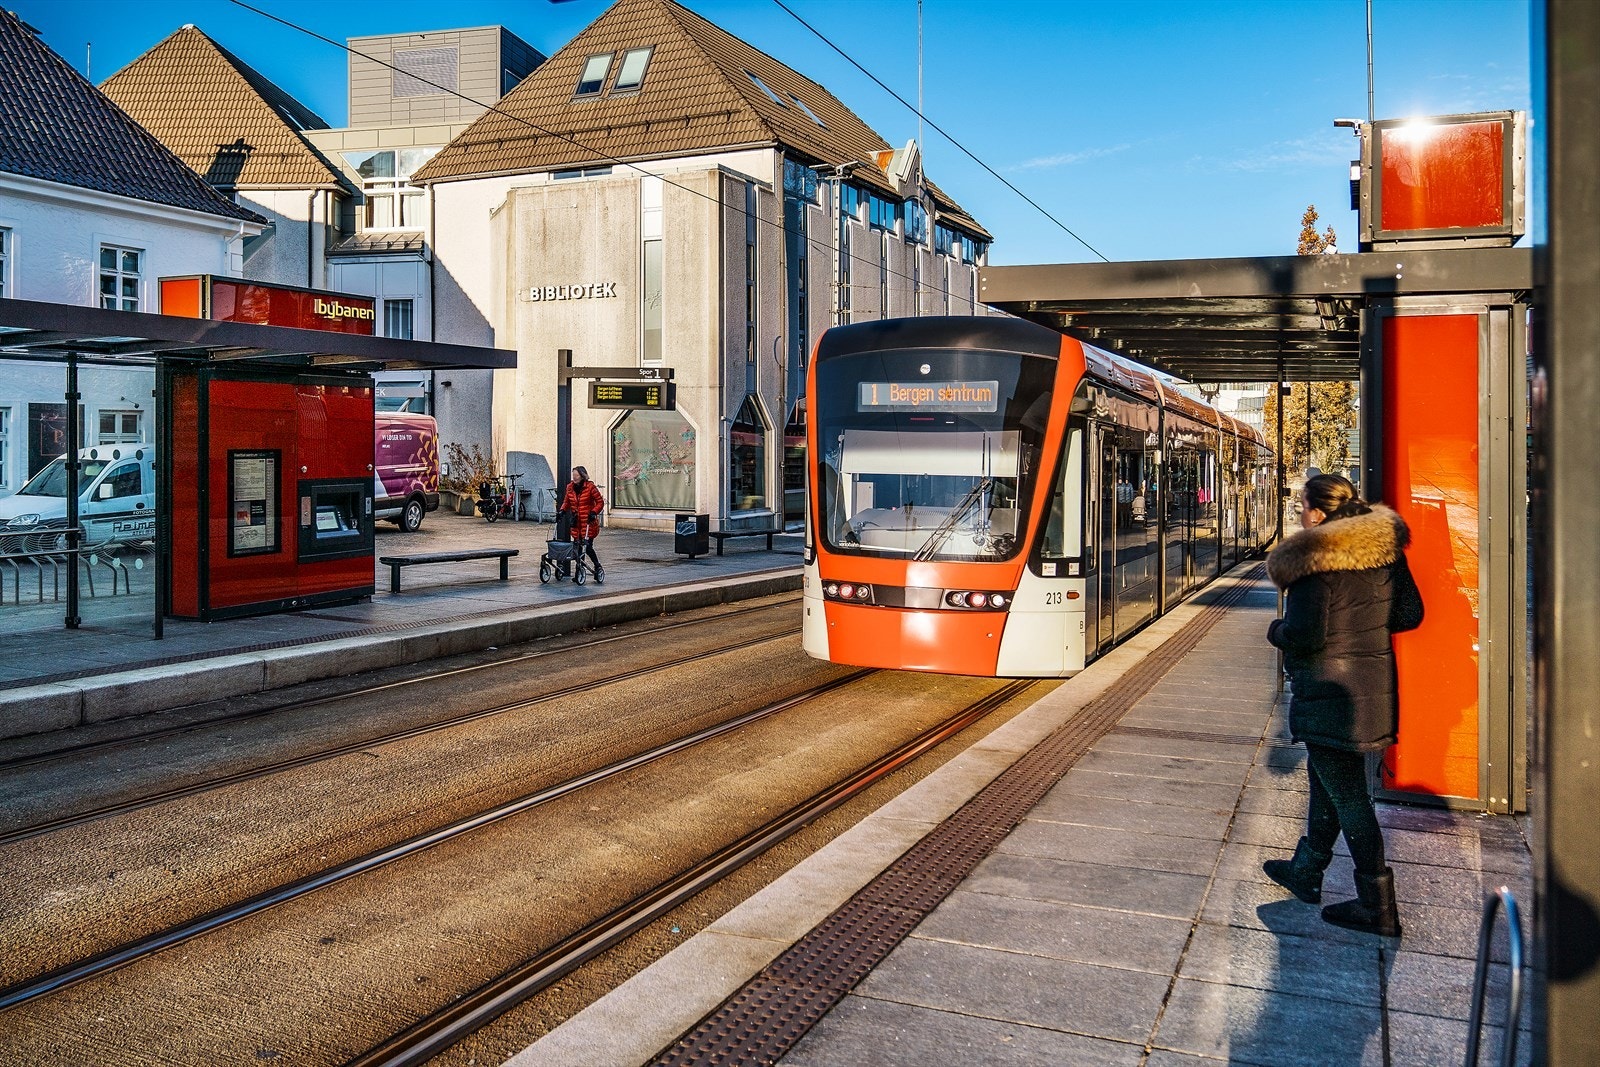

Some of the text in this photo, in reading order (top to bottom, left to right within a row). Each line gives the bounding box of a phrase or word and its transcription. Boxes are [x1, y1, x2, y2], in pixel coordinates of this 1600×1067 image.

[530, 282, 617, 302] BIBLIOTEK
[639, 368, 661, 378] Spor 1
[871, 383, 992, 405] 1 Bergen sentrum
[1046, 592, 1062, 604] 213
